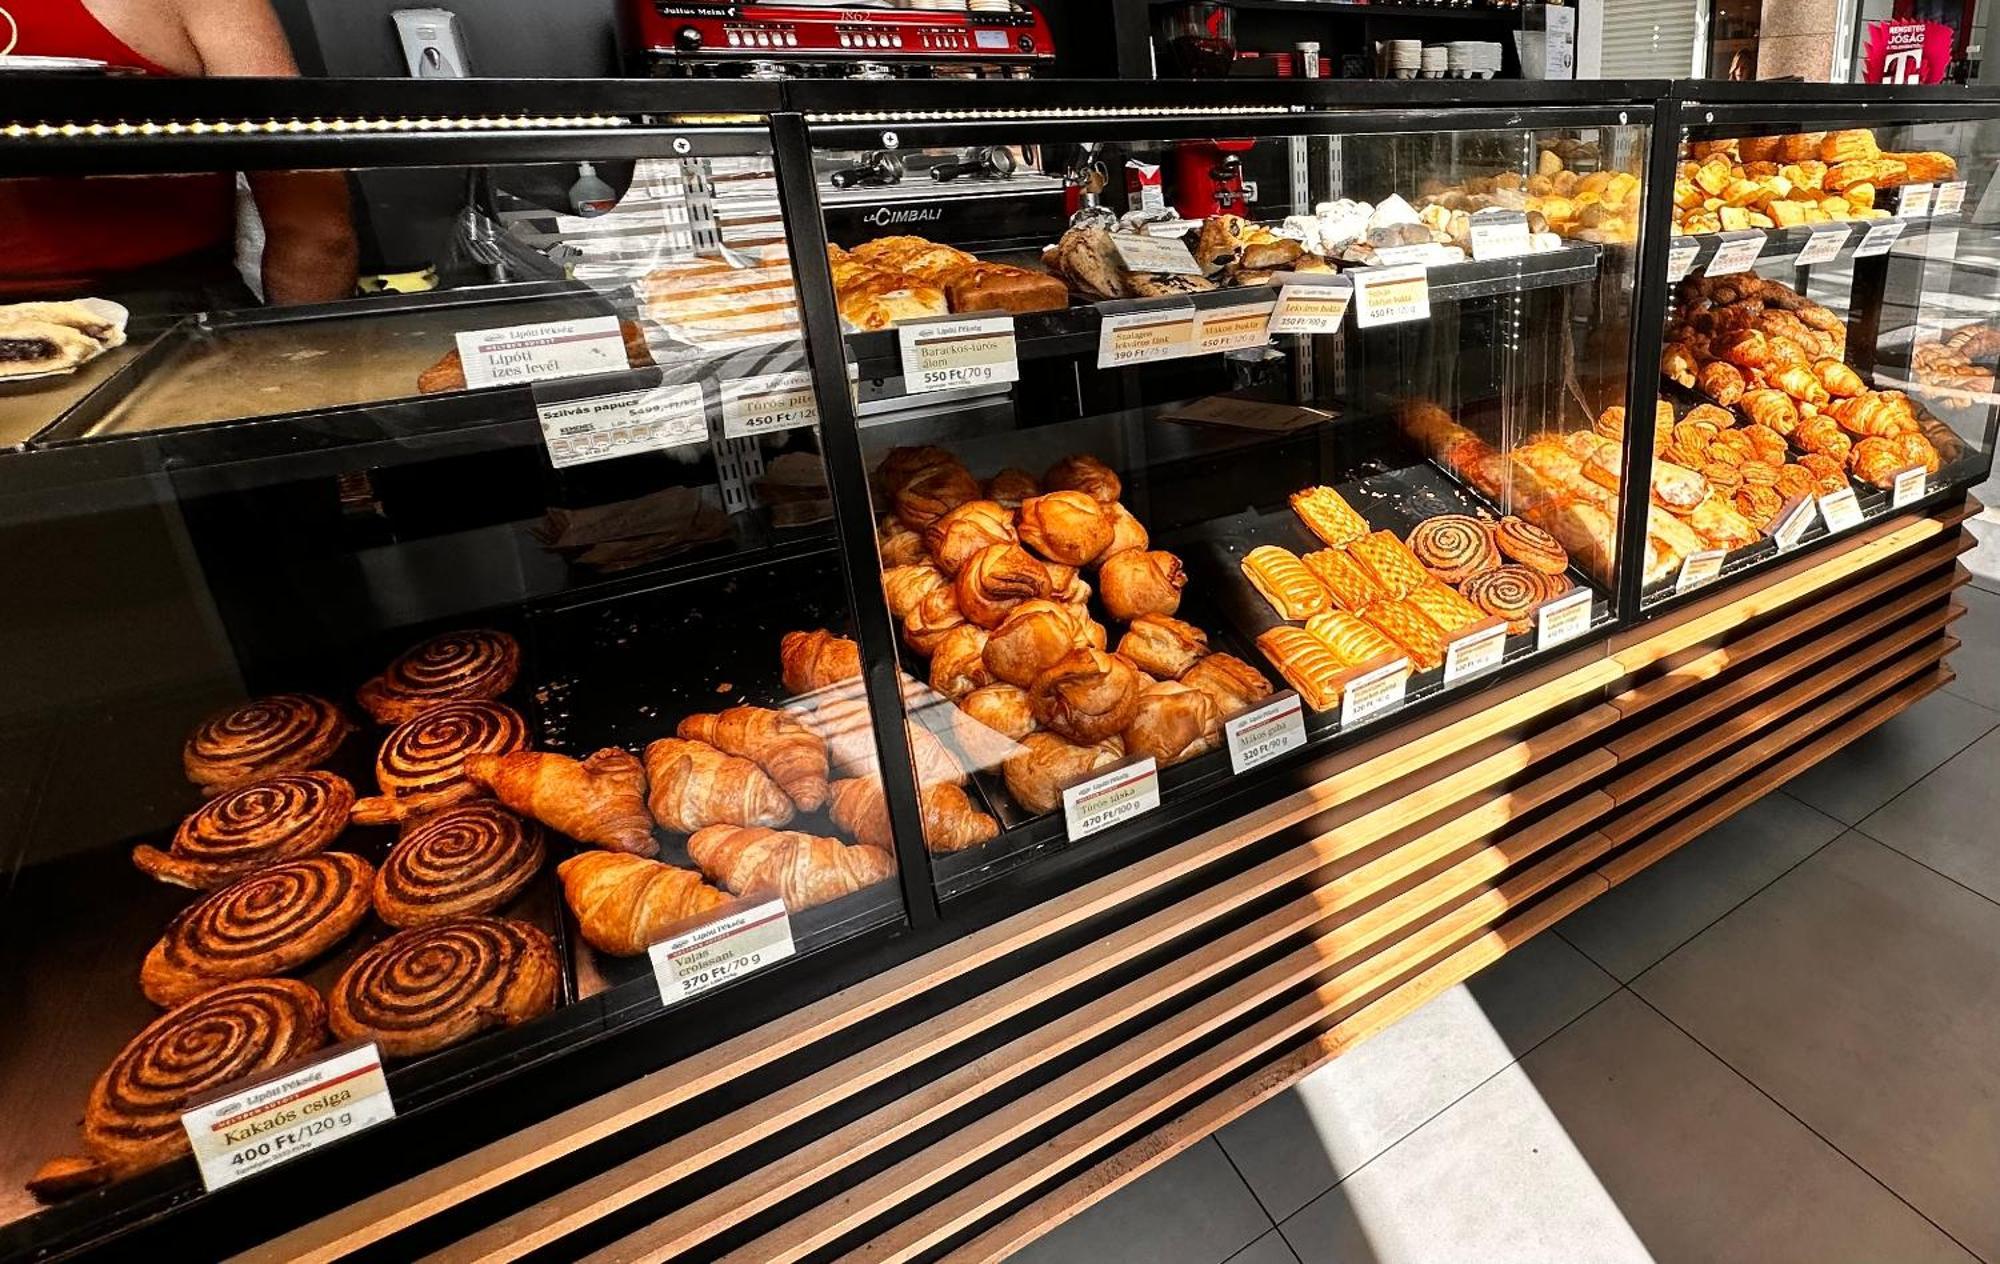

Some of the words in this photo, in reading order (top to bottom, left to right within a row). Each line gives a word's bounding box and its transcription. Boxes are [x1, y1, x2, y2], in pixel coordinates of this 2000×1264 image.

[663, 7, 695, 15] Julius
[1887, 32, 1925, 44] JÓSÁG
[1882, 48, 1923, 84] T
[1369, 309, 1385, 319] 450
[921, 341, 998, 358] Barackos-túrós
[1202, 339, 1219, 348] 450
[488, 351, 533, 367] Lipóti
[922, 358, 948, 369] álom
[1114, 351, 1133, 361] 390
[492, 366, 522, 378] ízes
[526, 360, 560, 375] levél
[924, 371, 946, 383] 550
[949, 367, 981, 379] Ft/70
[983, 366, 992, 378] g
[543, 406, 591, 420] Szilvás
[594, 399, 640, 413] papucs
[746, 400, 785, 412] Túrós
[746, 415, 773, 427] 450
[1242, 748, 1259, 761] 320
[1082, 815, 1101, 829] 470
[1102, 802, 1133, 821] Ft/100
[1133, 800, 1141, 810] g
[674, 949, 710, 968] Vajas
[678, 949, 735, 978] croissant
[681, 974, 709, 992] 370
[711, 957, 750, 979] Ft/70
[751, 953, 762, 966] g
[223, 1109, 297, 1147] Kakaós
[301, 1088, 353, 1116] csiga
[231, 1143, 271, 1167] 400
[275, 1115, 336, 1150] Ft/120
[339, 1111, 353, 1126] g
